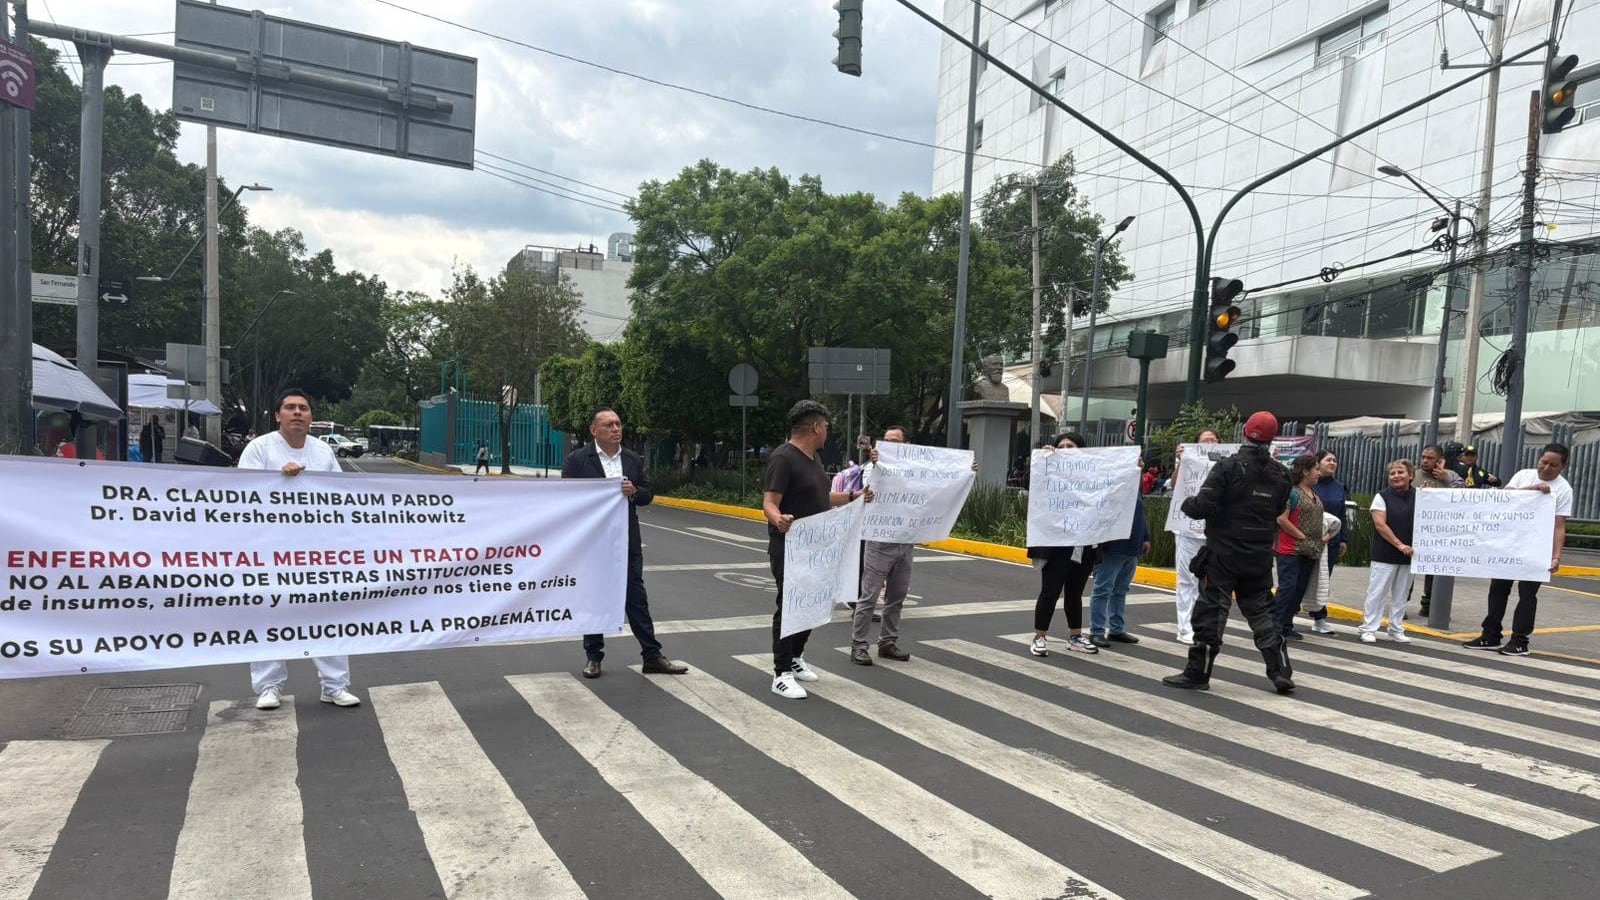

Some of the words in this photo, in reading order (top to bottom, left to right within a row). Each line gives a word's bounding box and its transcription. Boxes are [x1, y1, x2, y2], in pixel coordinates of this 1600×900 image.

[51, 280, 76, 288] Fernando
[102, 485, 158, 502] DRA.
[166, 488, 262, 504] CLAUDIA
[269, 491, 385, 506] SHEINBAUM
[392, 494, 454, 506] PARDO
[1450, 490, 1511, 503] EXIGIMOS
[91, 505, 124, 521] Dr.
[133, 507, 197, 522] David
[205, 508, 345, 524] Kershenobich
[351, 510, 466, 524] Stalnikowitz
[1473, 511, 1482, 520] DE
[1490, 512, 1536, 521] INSUMOS
[7, 550, 152, 568] ENFERMO
[162, 551, 265, 567] MENTAL
[273, 550, 366, 566] MERECE
[373, 549, 404, 564] UN
[410, 547, 479, 563] TRATO
[485, 544, 542, 560] DIGNO
[1471, 556, 1481, 565] DE
[9, 574, 48, 590] NO
[57, 574, 89, 589] AL
[98, 573, 234, 589] ABANDONO
[242, 572, 270, 587] DE
[278, 569, 380, 586] NUESTRAS
[386, 563, 514, 582] INSTITUCIONES
[1434, 565, 1463, 575] BASE
[0, 595, 32, 611] de
[42, 595, 154, 611] insumos,
[163, 593, 264, 607] alimento
[270, 593, 281, 607] y
[289, 585, 428, 604] mantenimiento
[433, 581, 463, 594] nos
[469, 579, 512, 592] tiene
[518, 580, 536, 591] en
[540, 574, 577, 589] crisis
[50, 638, 83, 656] SU
[94, 633, 184, 653] APOYO
[193, 628, 258, 647] PARA
[266, 620, 402, 642] SOLUCIONAR
[410, 618, 434, 633] LA
[441, 607, 573, 632] PROBLEMÁTICA
